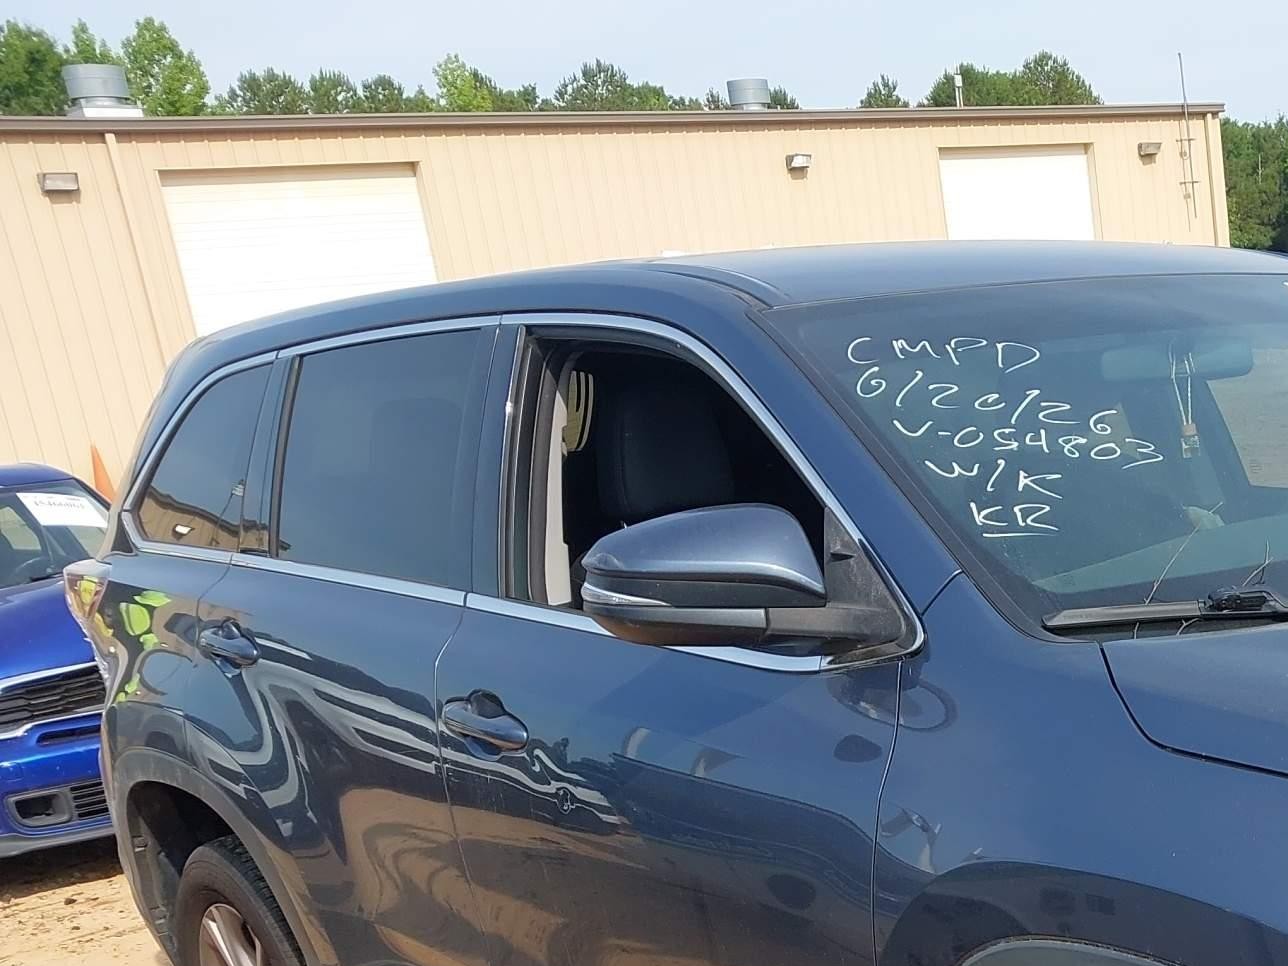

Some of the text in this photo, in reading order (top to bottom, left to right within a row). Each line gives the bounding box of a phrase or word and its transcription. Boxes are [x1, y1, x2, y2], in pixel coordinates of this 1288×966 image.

[847, 337, 1040, 373] CMPD
[856, 366, 1118, 435] 6/20/26
[893, 419, 1164, 469] V-054803
[969, 502, 1059, 532] KR
